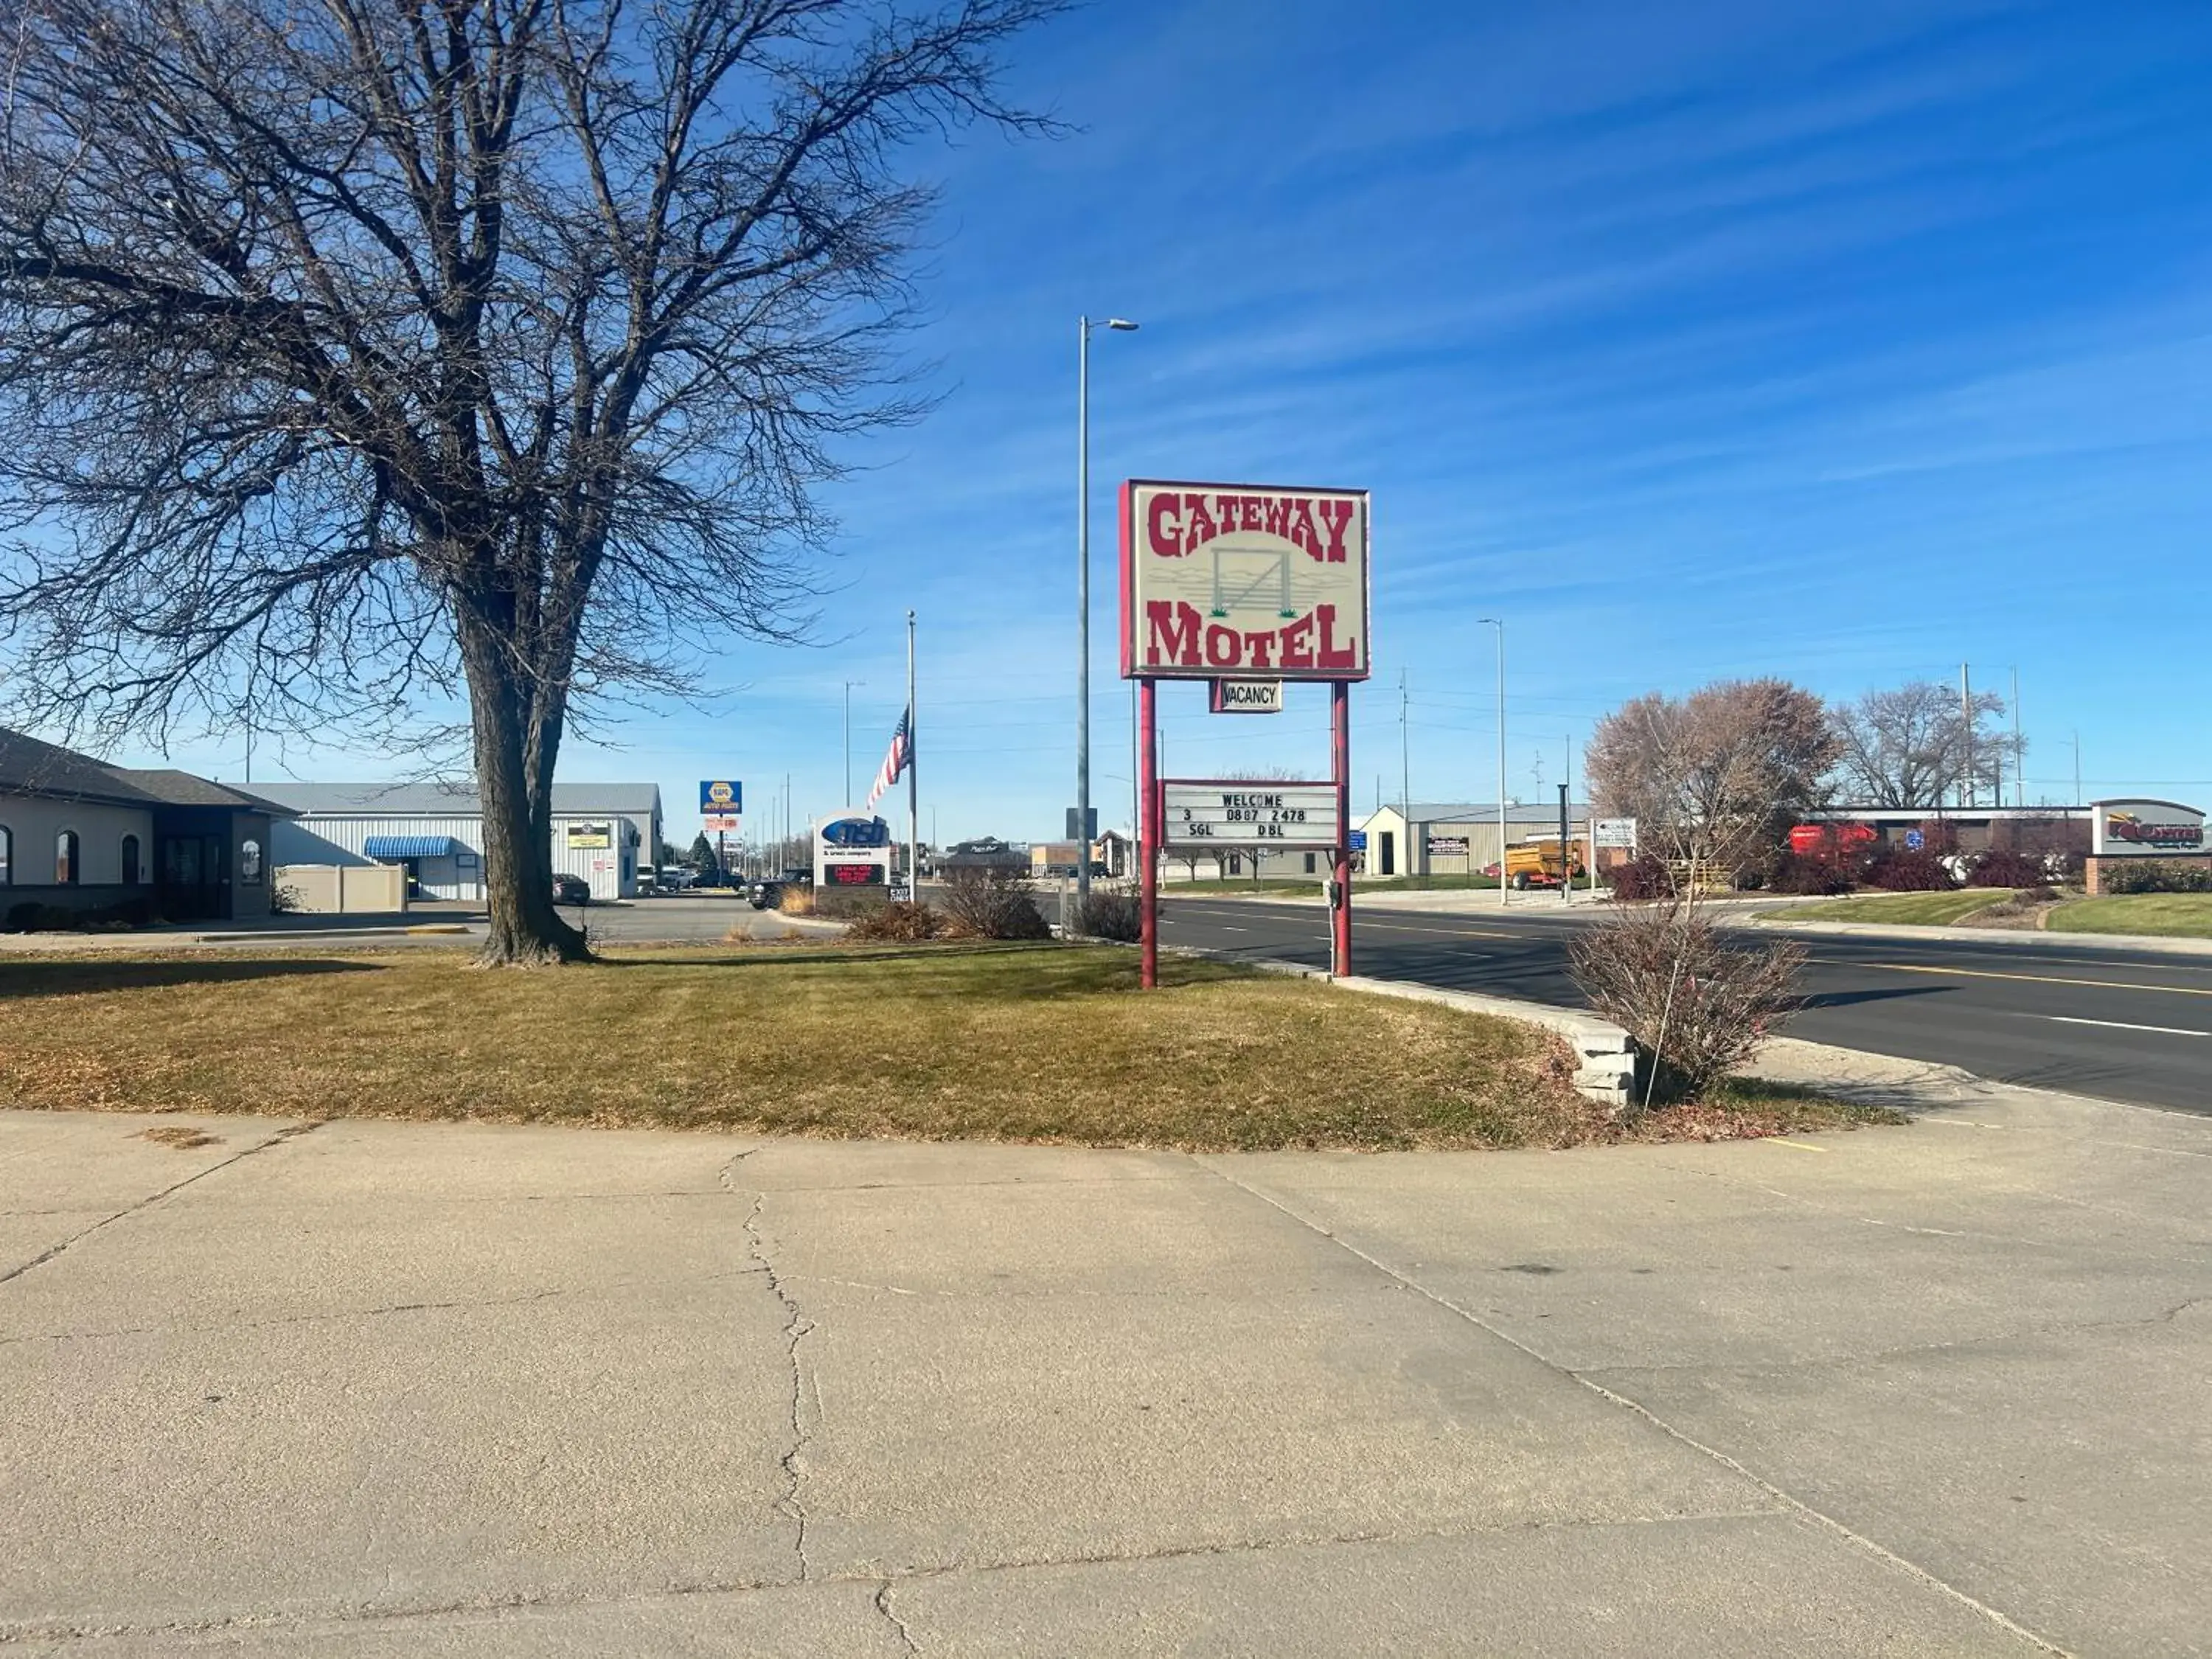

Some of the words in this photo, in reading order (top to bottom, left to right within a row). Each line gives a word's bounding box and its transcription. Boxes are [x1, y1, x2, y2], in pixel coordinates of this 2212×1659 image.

[1147, 492, 1353, 563] GATEWAY
[1147, 600, 1356, 669] MOTEL
[1223, 686, 1276, 704] VACANCY
[1222, 794, 1282, 807] WELCOME
[1183, 808, 1192, 821] 3
[1189, 824, 1214, 835] SGL
